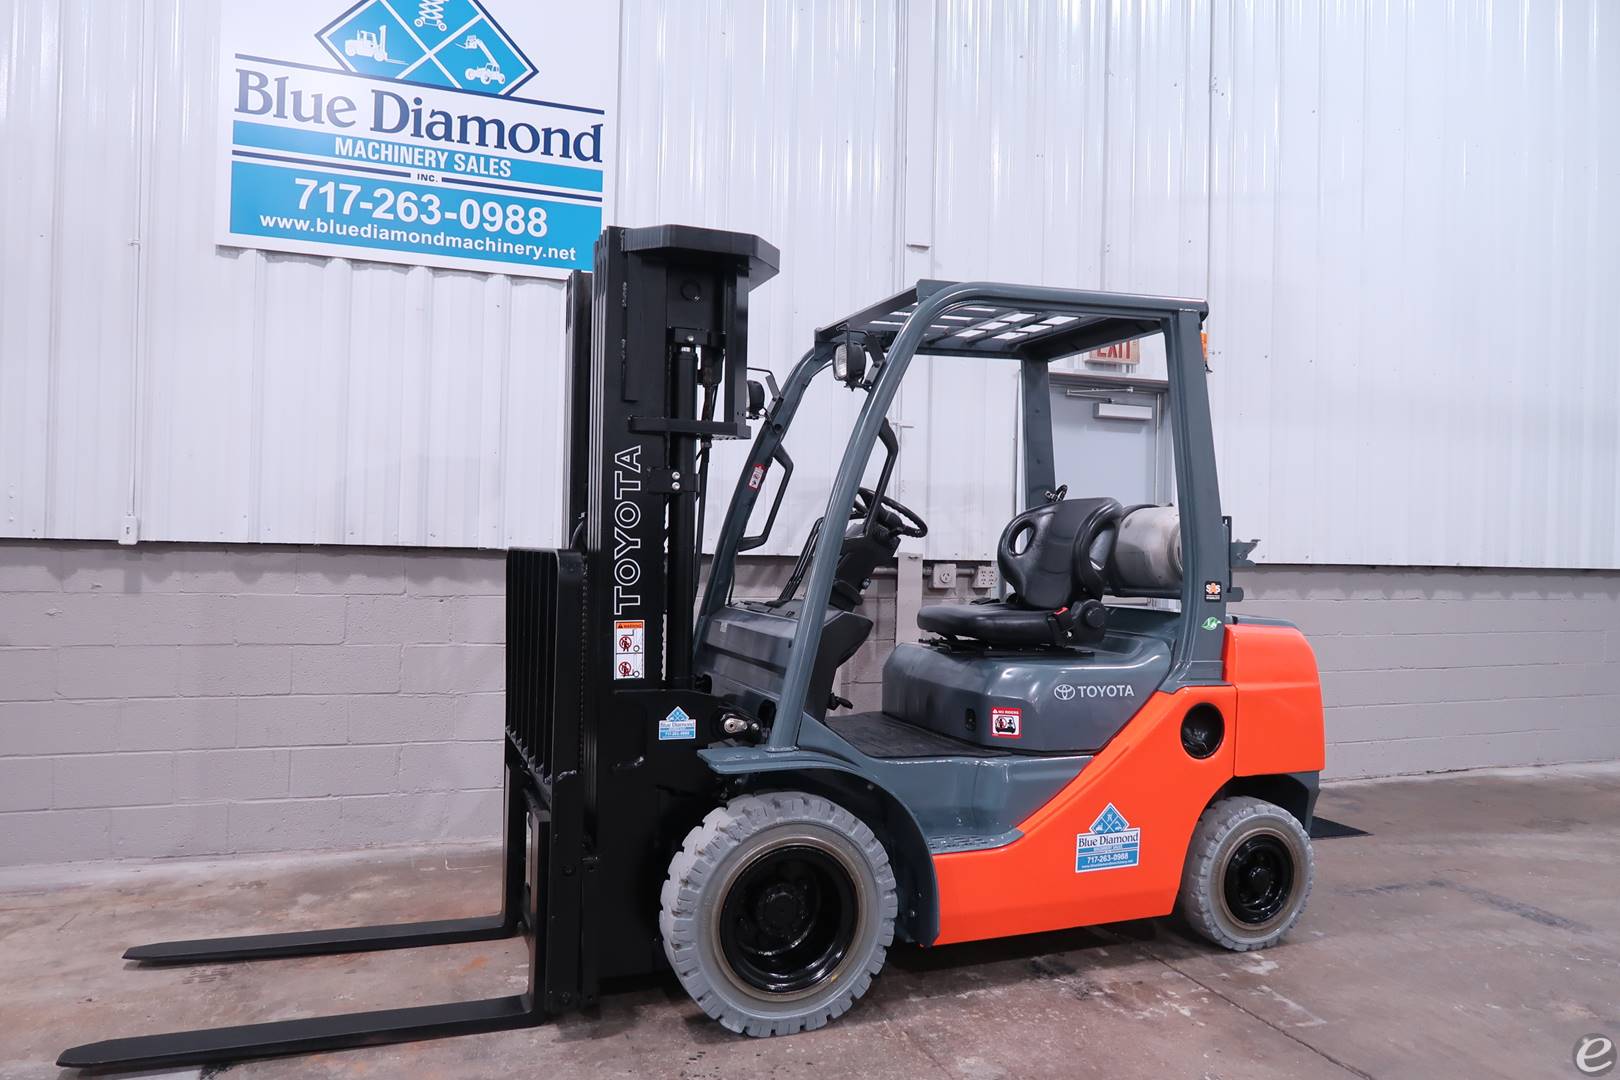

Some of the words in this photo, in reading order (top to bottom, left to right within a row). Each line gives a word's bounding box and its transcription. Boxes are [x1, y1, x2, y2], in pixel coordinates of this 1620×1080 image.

[234, 68, 357, 128] Blue
[370, 89, 603, 163] Diamond
[335, 137, 448, 169] MACHINERY
[453, 153, 512, 178] SALES
[417, 173, 438, 183] INC.
[294, 178, 548, 237] 717-263-0988
[259, 215, 577, 261] www.bluediamondmachinery.net
[614, 444, 641, 615] TOYOTA
[1077, 684, 1135, 698] TOYOTA
[1078, 837, 1098, 848] Blue
[1100, 832, 1138, 845] Diamond
